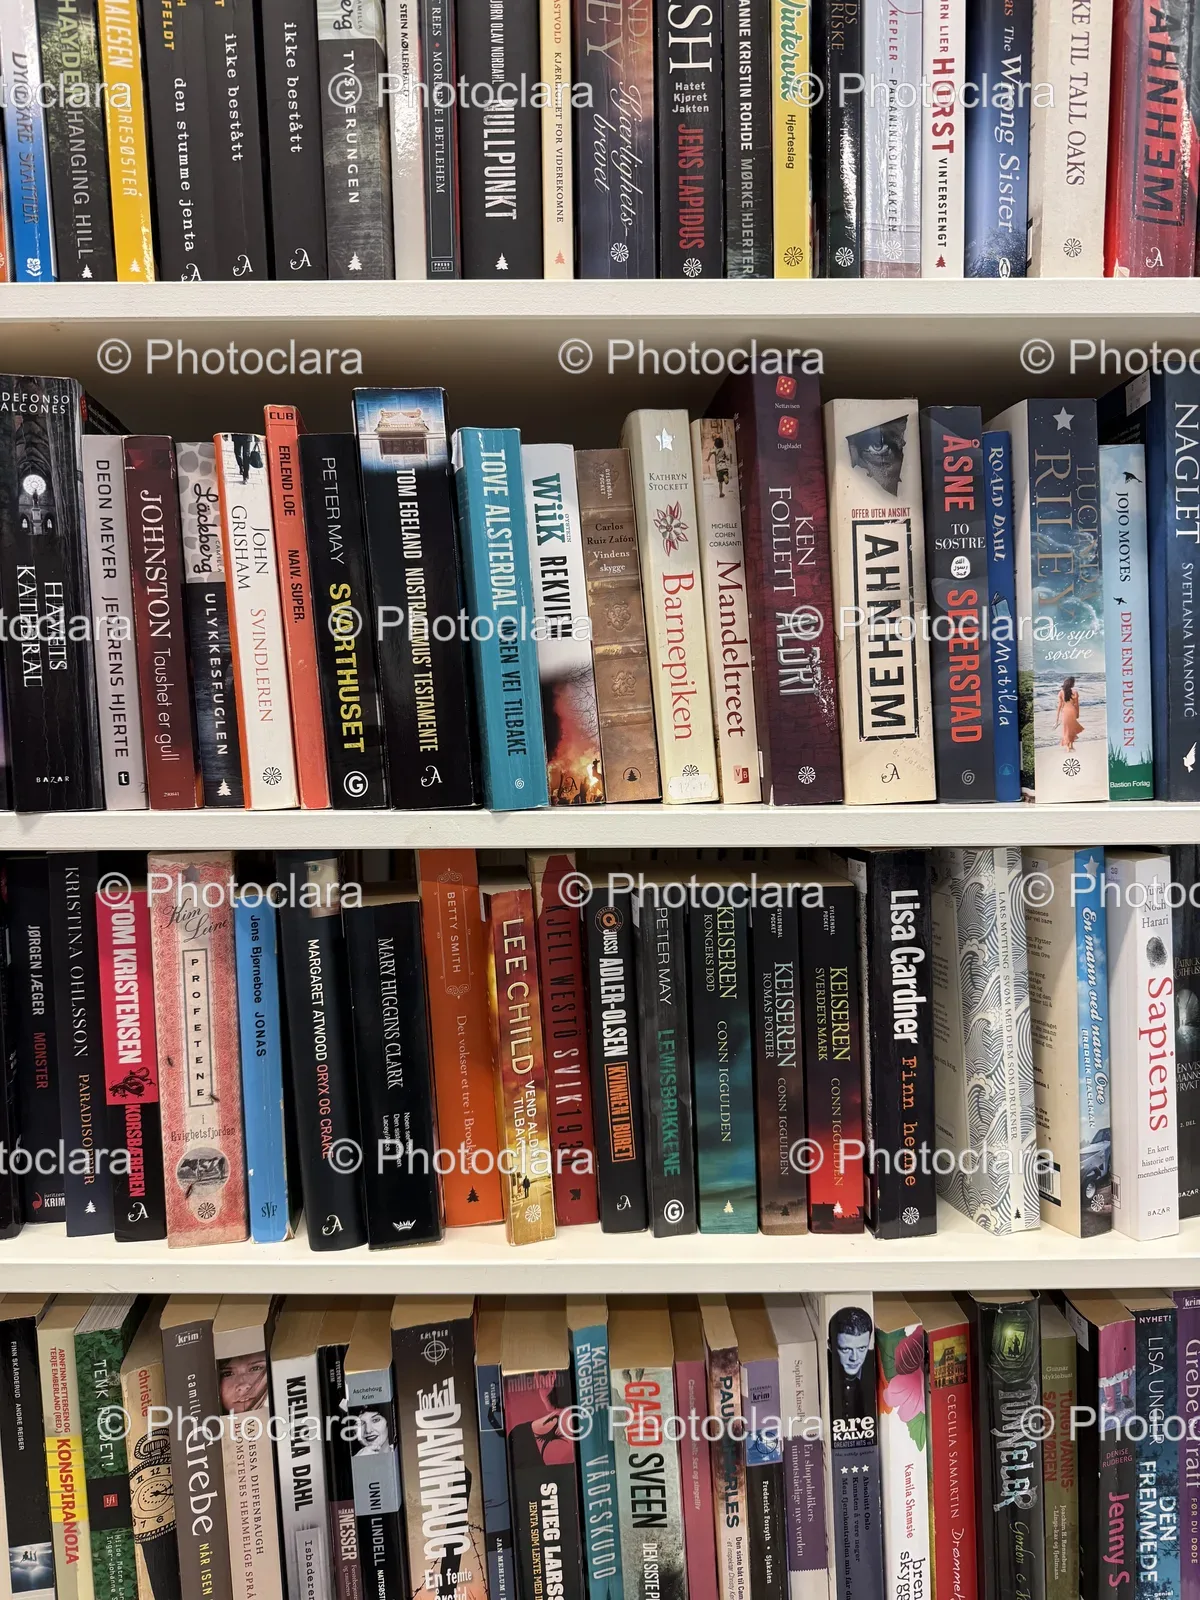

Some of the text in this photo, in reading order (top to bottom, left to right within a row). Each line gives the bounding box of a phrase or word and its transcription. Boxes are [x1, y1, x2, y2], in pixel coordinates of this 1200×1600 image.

[1004, 26, 1014, 52] The
[224, 33, 244, 162] ikke bestått
[284, 21, 304, 154] ikke bestått
[672, 104, 709, 113] Jakten
[673, 92, 707, 102] Kjøret
[675, 82, 705, 91] Hatet
[1066, 32, 1089, 187] TIL TALL OAKS
[67, 109, 94, 260] HANGING HILL
[173, 78, 197, 252] den stumme jenta
[483, 99, 517, 220] NULLPUNKT
[556, 147, 564, 223] VIDEREKOMNE
[677, 124, 705, 249] JENS LAPIDUS
[739, 41, 754, 274] KRISTIN ROHDE MØRKE HJERTER
[785, 114, 796, 169] Hjerteslag
[931, 58, 955, 248] HORST VINTERSTENGT
[998, 151, 1020, 234] Sister
[269, 410, 295, 421] CUB
[278, 445, 296, 517] ERLEND LOE
[322, 456, 345, 565] PETER MAY
[396, 468, 422, 560] TOM EGELAND
[648, 472, 688, 481] KATHRYN
[648, 481, 689, 491] STOCKETT
[851, 506, 911, 518] OFFER UTEN ANSIKT
[942, 434, 981, 513] ÅSNE
[96, 460, 117, 581] DEON MEYER
[139, 489, 174, 639] JOHNSTON
[230, 504, 252, 592] GRISHAM
[250, 526, 269, 575] JOHN
[479, 449, 516, 611] TOVE ALSTERDAL
[586, 533, 634, 546] Ruiz Zafón
[592, 549, 631, 559] Vindens
[595, 521, 624, 532] Carlos
[768, 485, 797, 597] FOLLETT
[795, 515, 816, 566] KEN
[934, 536, 986, 551] SØSTRE
[951, 523, 970, 535] TO
[1115, 492, 1131, 583] JOJO MOYES
[288, 549, 306, 624] NAIV. SUPER.
[540, 555, 573, 640] REKVIEM
[599, 564, 626, 574] skygge
[204, 592, 228, 756] ULYKKESFUGLEN
[250, 608, 274, 723] SVINDLEREN
[329, 583, 365, 754] SVARTHUSET
[661, 571, 700, 742] Barnepiken
[715, 560, 748, 739] Mandeltreet
[1120, 611, 1135, 748] DEN ENE PLUSS EN
[27, 924, 45, 1016] JØRGEN JÆGER
[65, 867, 89, 1058] KRISTINA OHLSSON
[446, 891, 461, 974] BETTY SMITH
[656, 907, 672, 1006] PETER MAY
[717, 905, 738, 1000] KEISEREN
[890, 888, 925, 1044] Lisa Gardner
[110, 900, 143, 1065] TOM KRISTENSEN
[249, 915, 266, 1057] Jens Bjørneboe JONAS
[307, 939, 328, 1062] MARGARET ATWOOD
[378, 937, 403, 1091] MARY HIGGINS CLARK
[501, 918, 534, 1075] LEE CHILD
[598, 957, 628, 1058] ADLER-OLSEN
[774, 961, 796, 1068] KEISEREN
[829, 966, 851, 1061] KEISEREN
[33, 1032, 49, 1089] MONSTER
[716, 1020, 732, 1143] CONN IGGULDEN
[1138, 976, 1174, 1132] Sapiens
[657, 1029, 680, 1178] LEWISBRIKKENE
[1139, 1315, 1172, 1323] NYHET!
[1148, 1337, 1164, 1375] LISA
[591, 1346, 607, 1412] KATRINE
[832, 1416, 875, 1431] are
[833, 1430, 874, 1441] KALVØ
[947, 1394, 959, 1518] CECILIA SAMARTIN
[56, 1438, 79, 1565] KONSPIRANOIA
[292, 1464, 313, 1511] DAHL
[368, 1481, 384, 1566] UNNI LINDELL
[585, 1454, 616, 1580] VÅDESKUDD
[628, 1452, 668, 1528] SVEEN
[763, 1512, 771, 1542] Forsyth
[904, 1463, 913, 1539] Kamila Shamsie
[1138, 1461, 1158, 1583] FREMMEDE
[1159, 1496, 1177, 1541] DEN
[338, 1514, 357, 1561] NESSER
[1103, 1492, 1130, 1588] Jenny S
